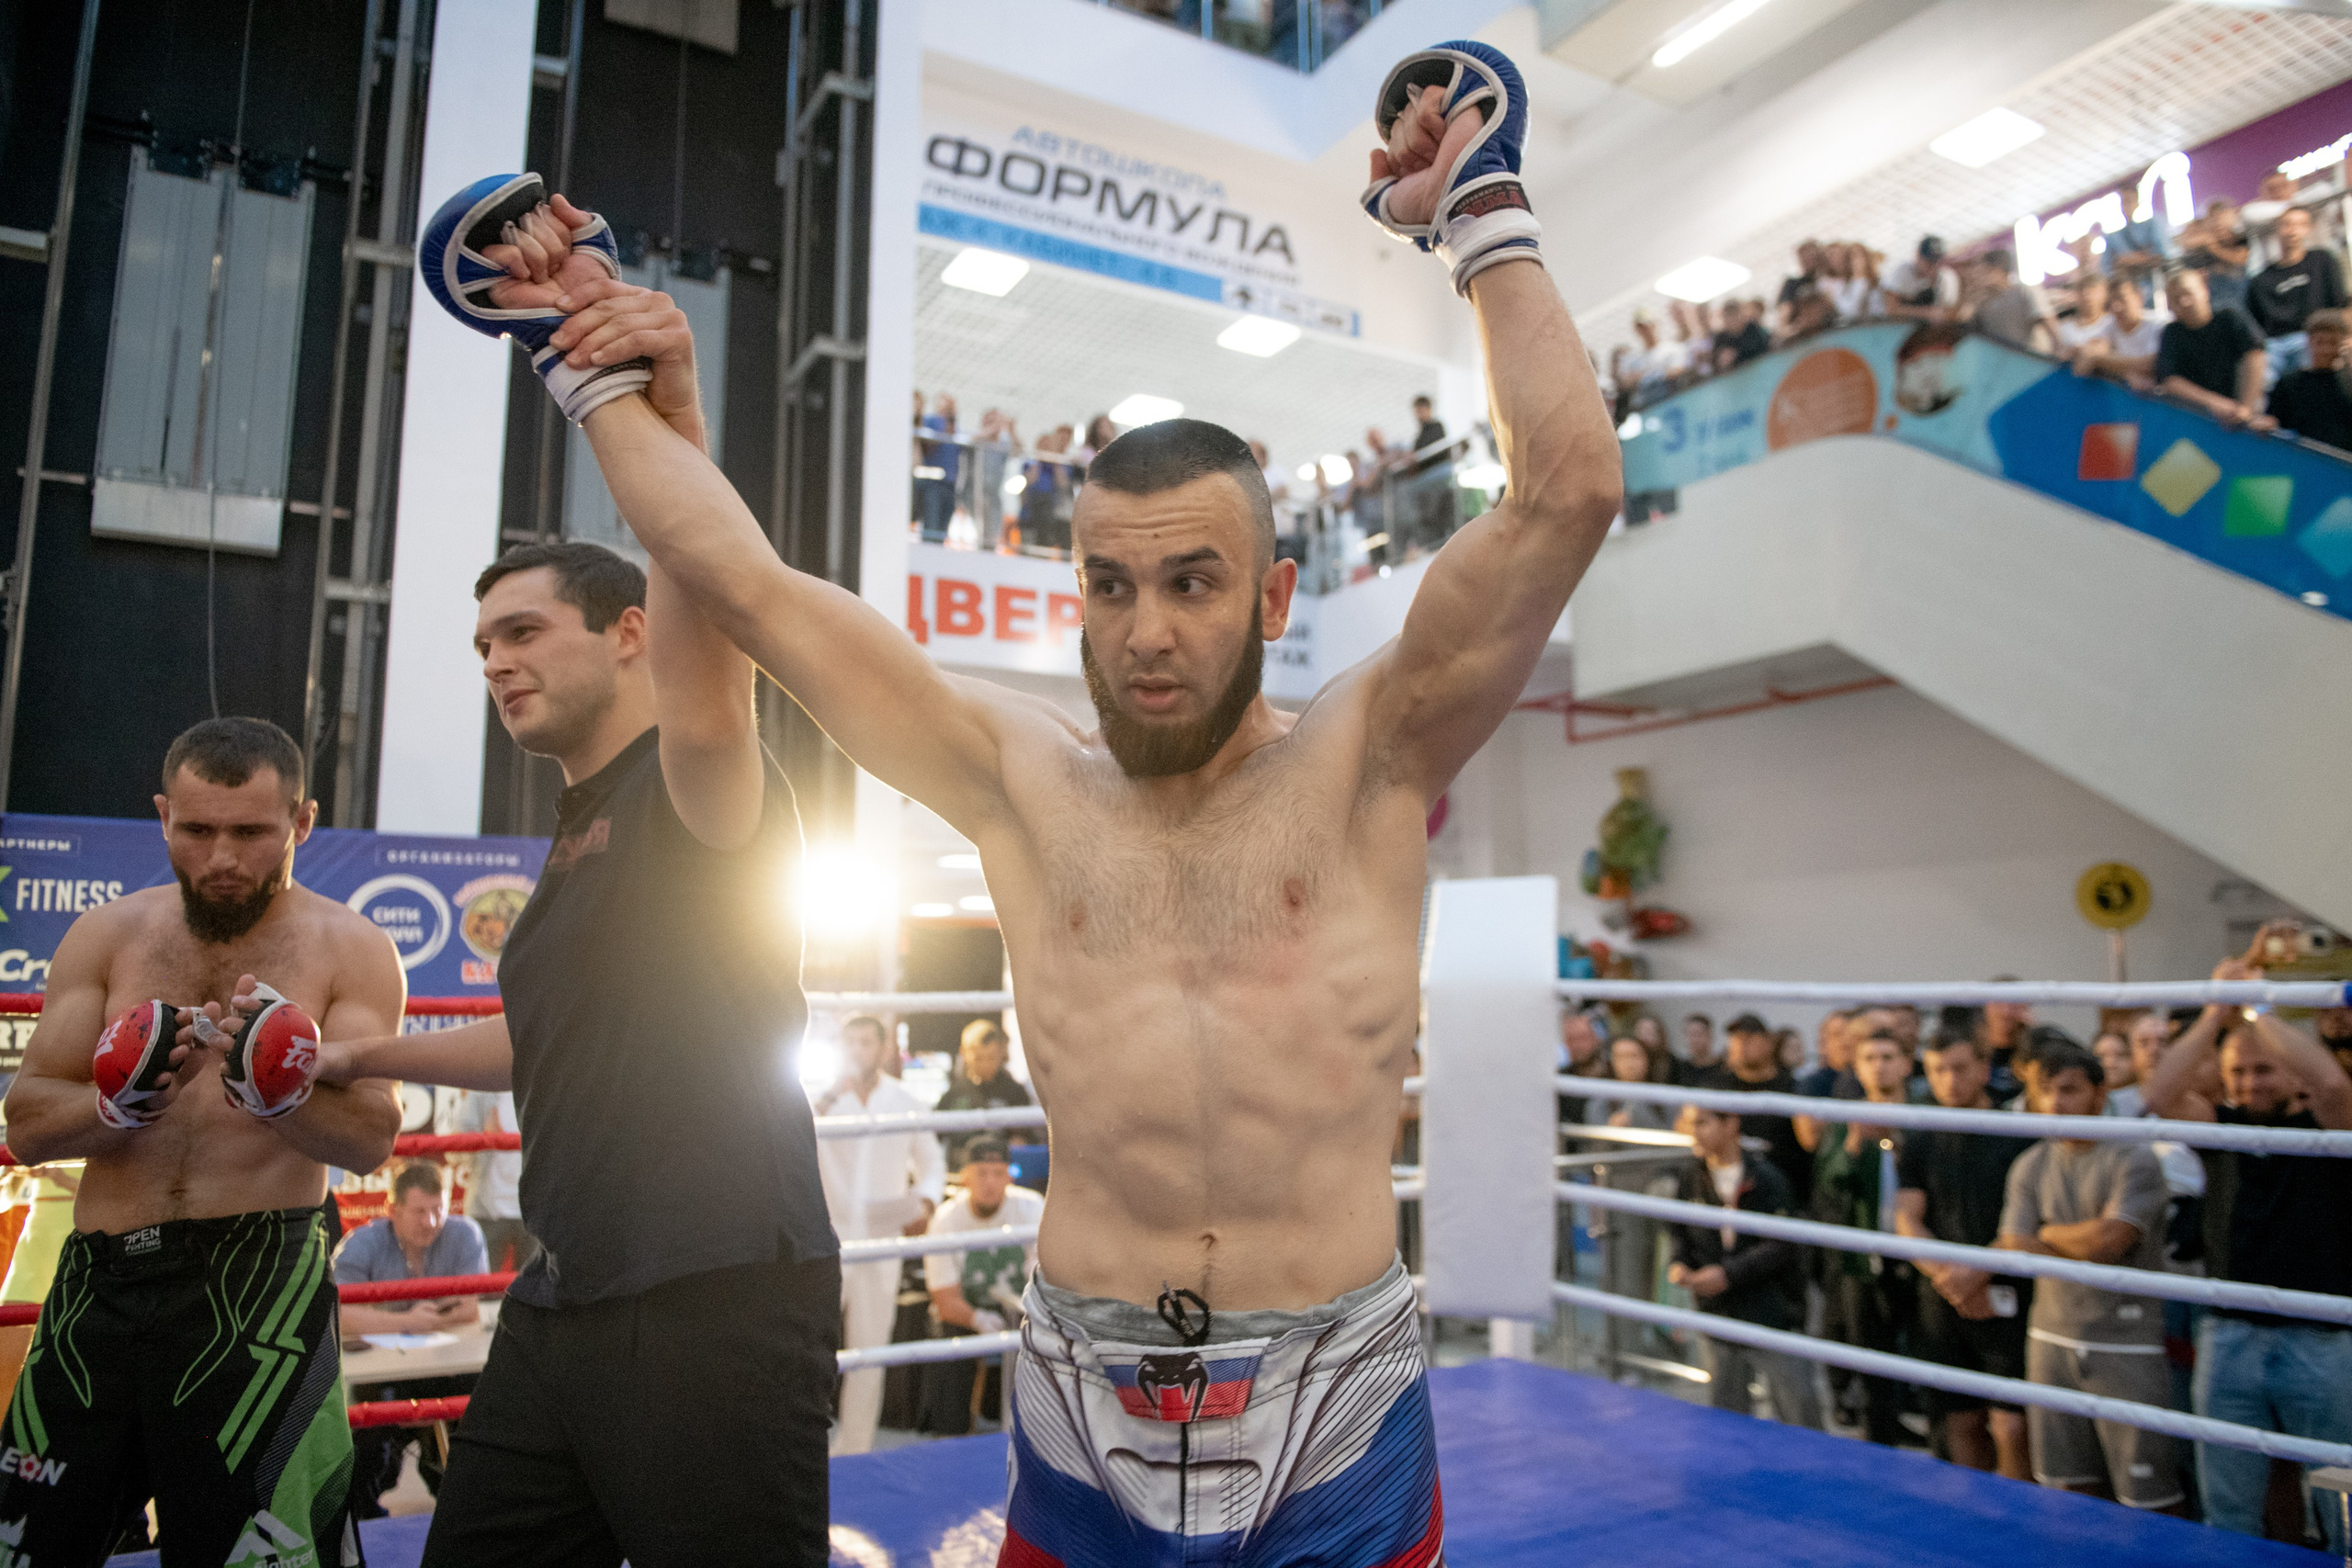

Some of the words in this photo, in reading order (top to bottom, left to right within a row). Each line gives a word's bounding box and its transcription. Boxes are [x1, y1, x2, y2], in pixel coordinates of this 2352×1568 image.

[1012, 124, 1226, 198] АВТОШКОЛА
[926, 133, 1295, 265] ФОРМУЛА
[16, 878, 123, 913] FITNESS
[372, 906, 421, 924] СИТИ
